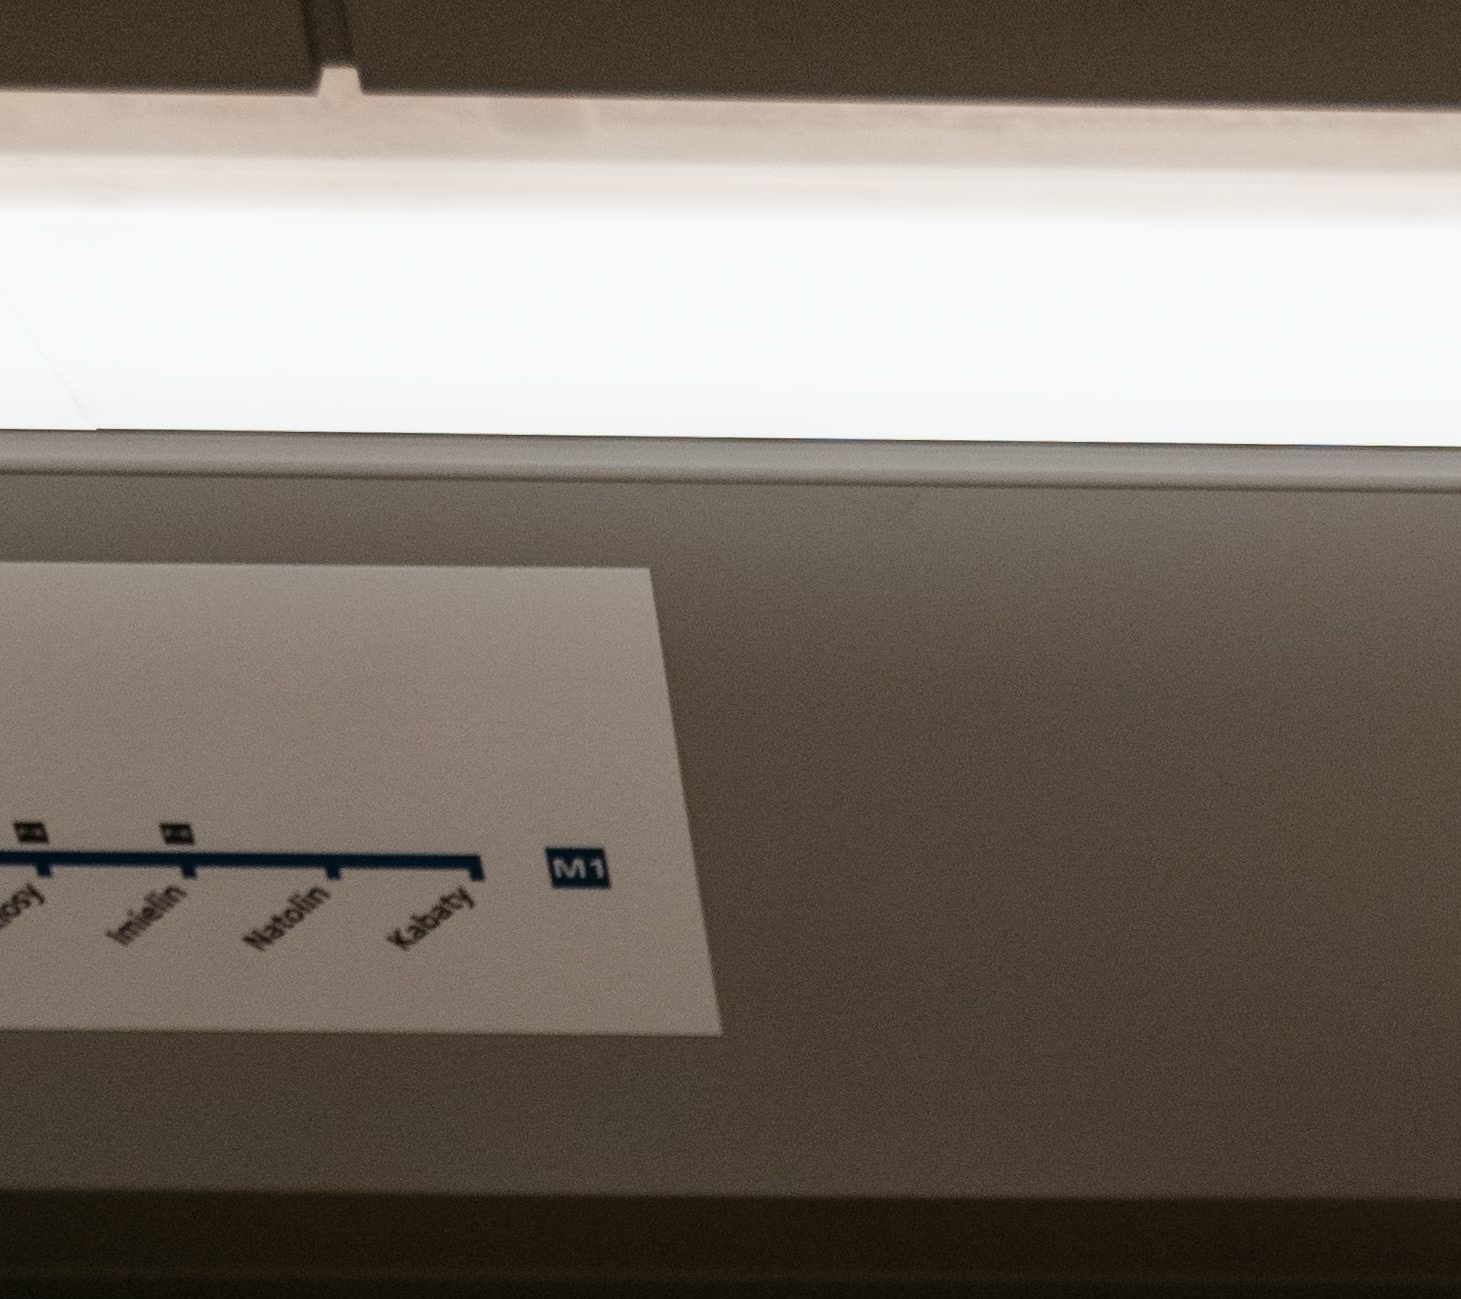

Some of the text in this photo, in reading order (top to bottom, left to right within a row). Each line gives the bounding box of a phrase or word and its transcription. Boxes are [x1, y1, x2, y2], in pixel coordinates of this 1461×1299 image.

[552, 857, 606, 879] M1
[104, 884, 188, 948] Imielin
[242, 885, 333, 952] Natolin
[386, 886, 477, 952] Kabaty
